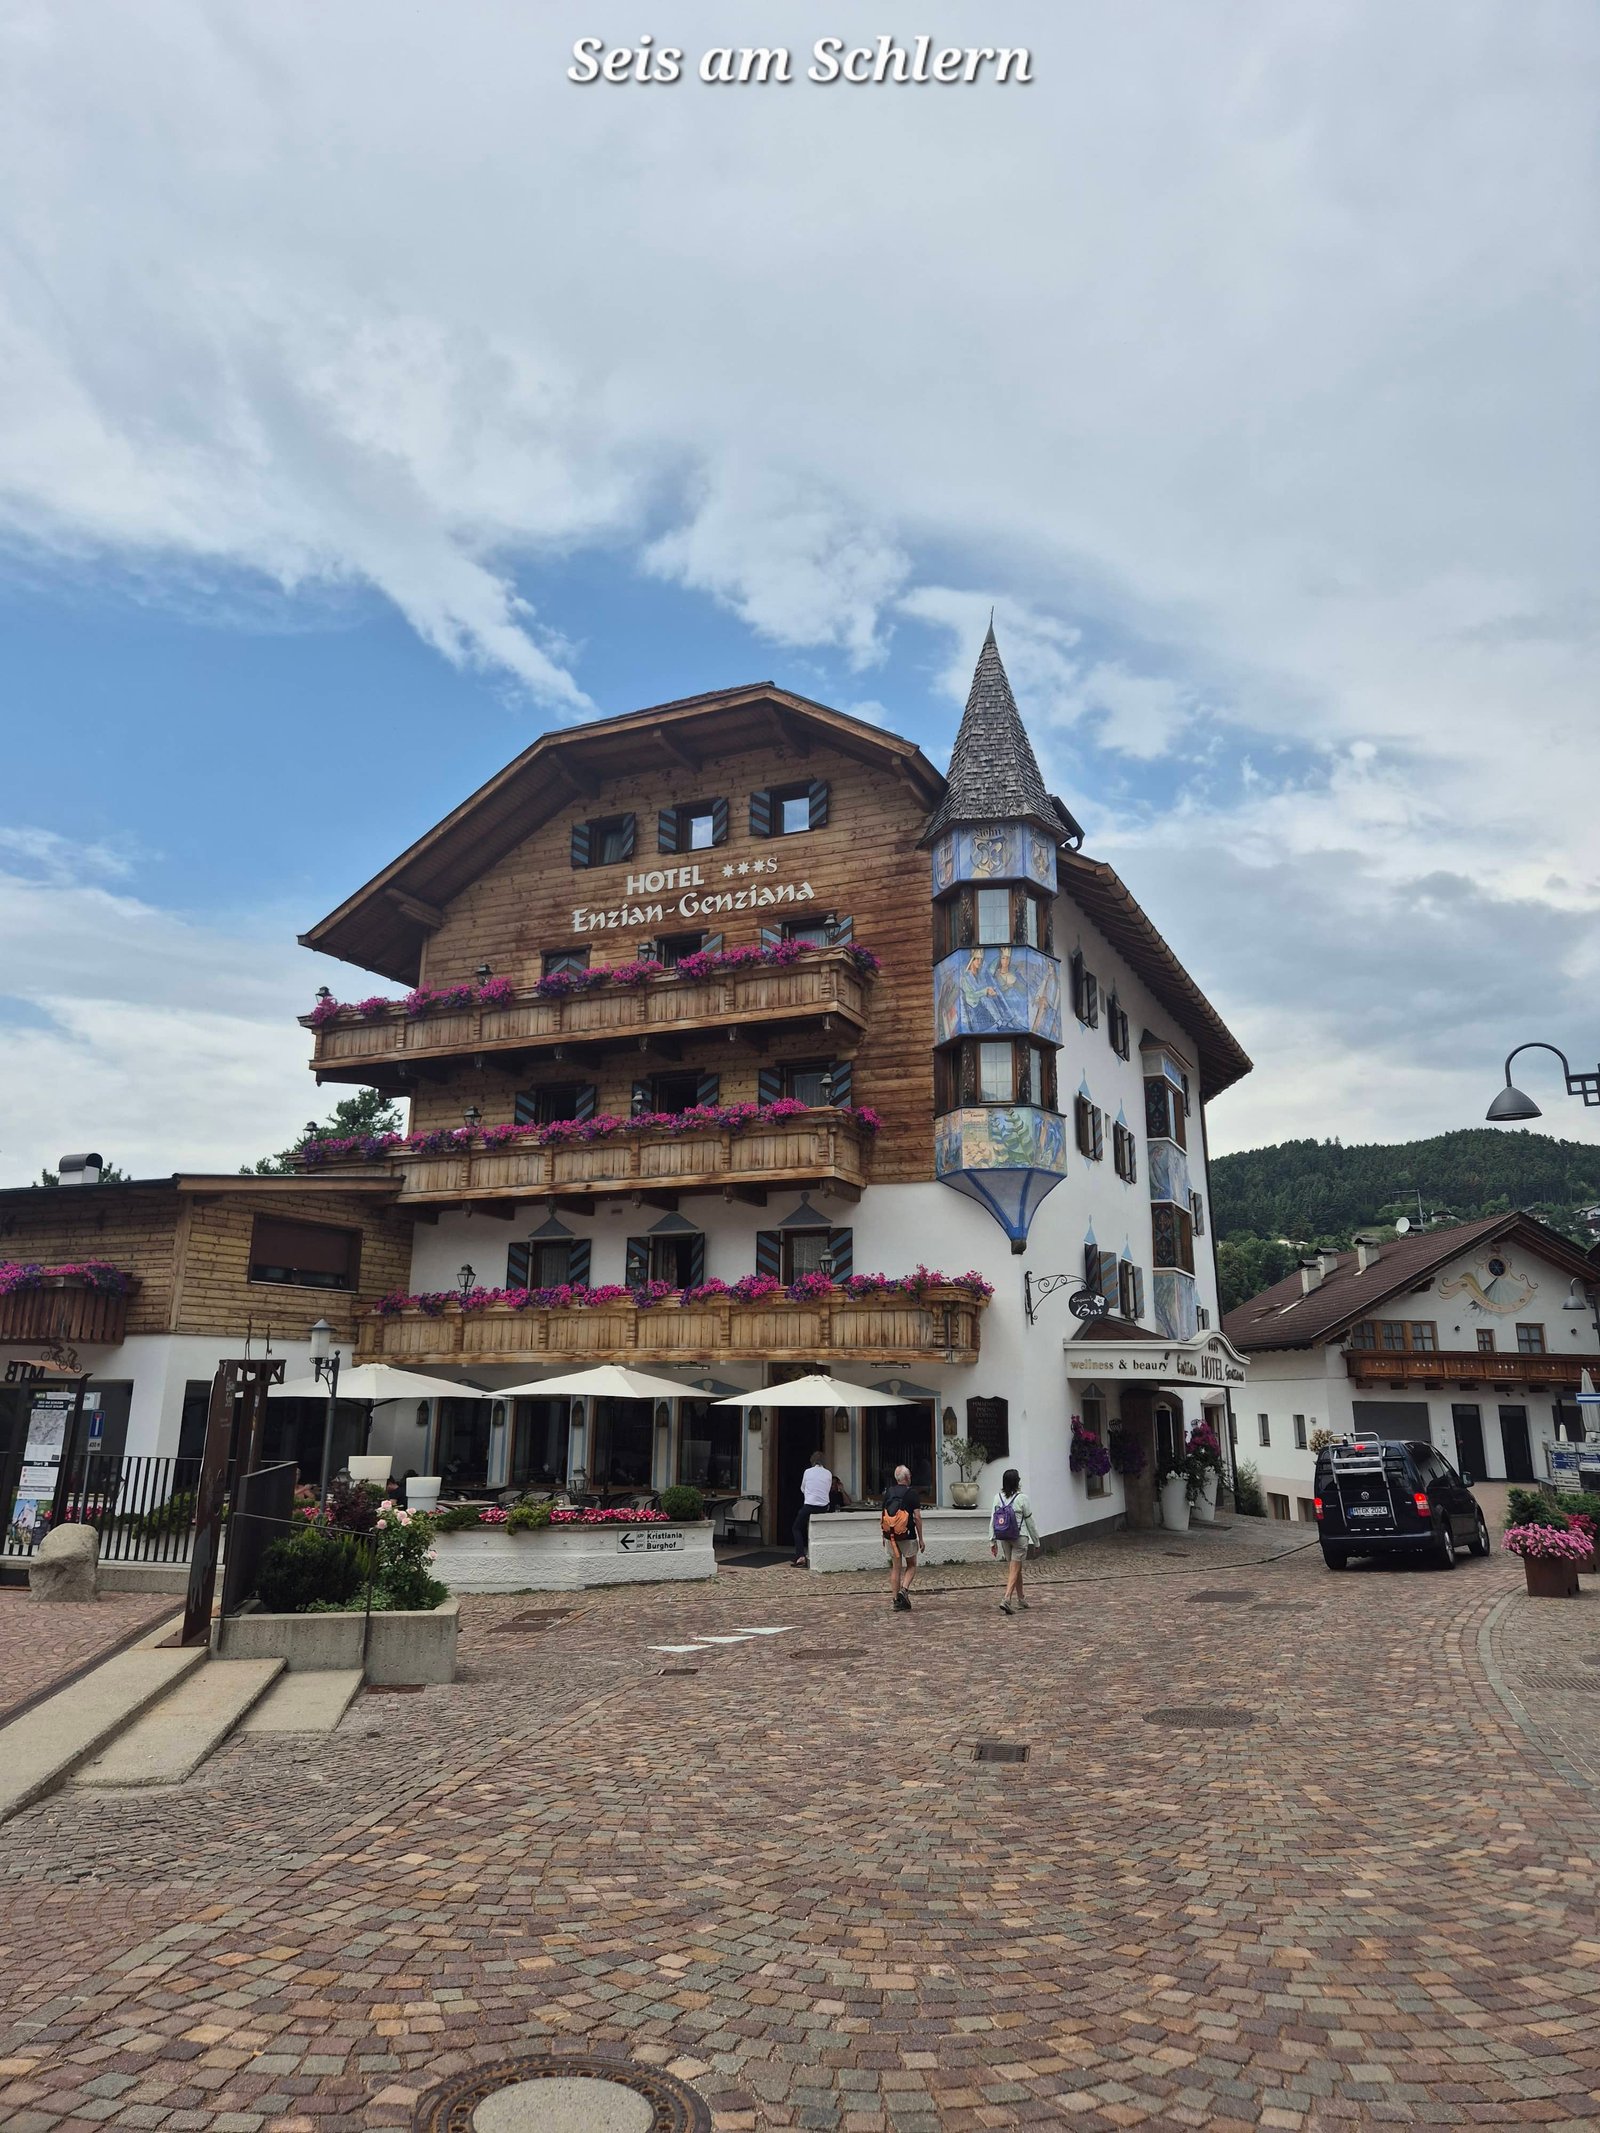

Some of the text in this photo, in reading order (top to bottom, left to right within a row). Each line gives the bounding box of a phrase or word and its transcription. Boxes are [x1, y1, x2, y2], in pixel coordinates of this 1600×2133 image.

[626, 865, 704, 896] HOTEL
[571, 881, 815, 933] Enzian-Genziana
[1076, 1303, 1102, 1317] Bar
[1071, 1359, 1169, 1372] wellness & beauty
[1201, 1355, 1224, 1381] HOTEL
[1371, 1506, 1387, 1514] 2024
[646, 1532, 683, 1540] Kristiania
[646, 1541, 677, 1550] Burghof
